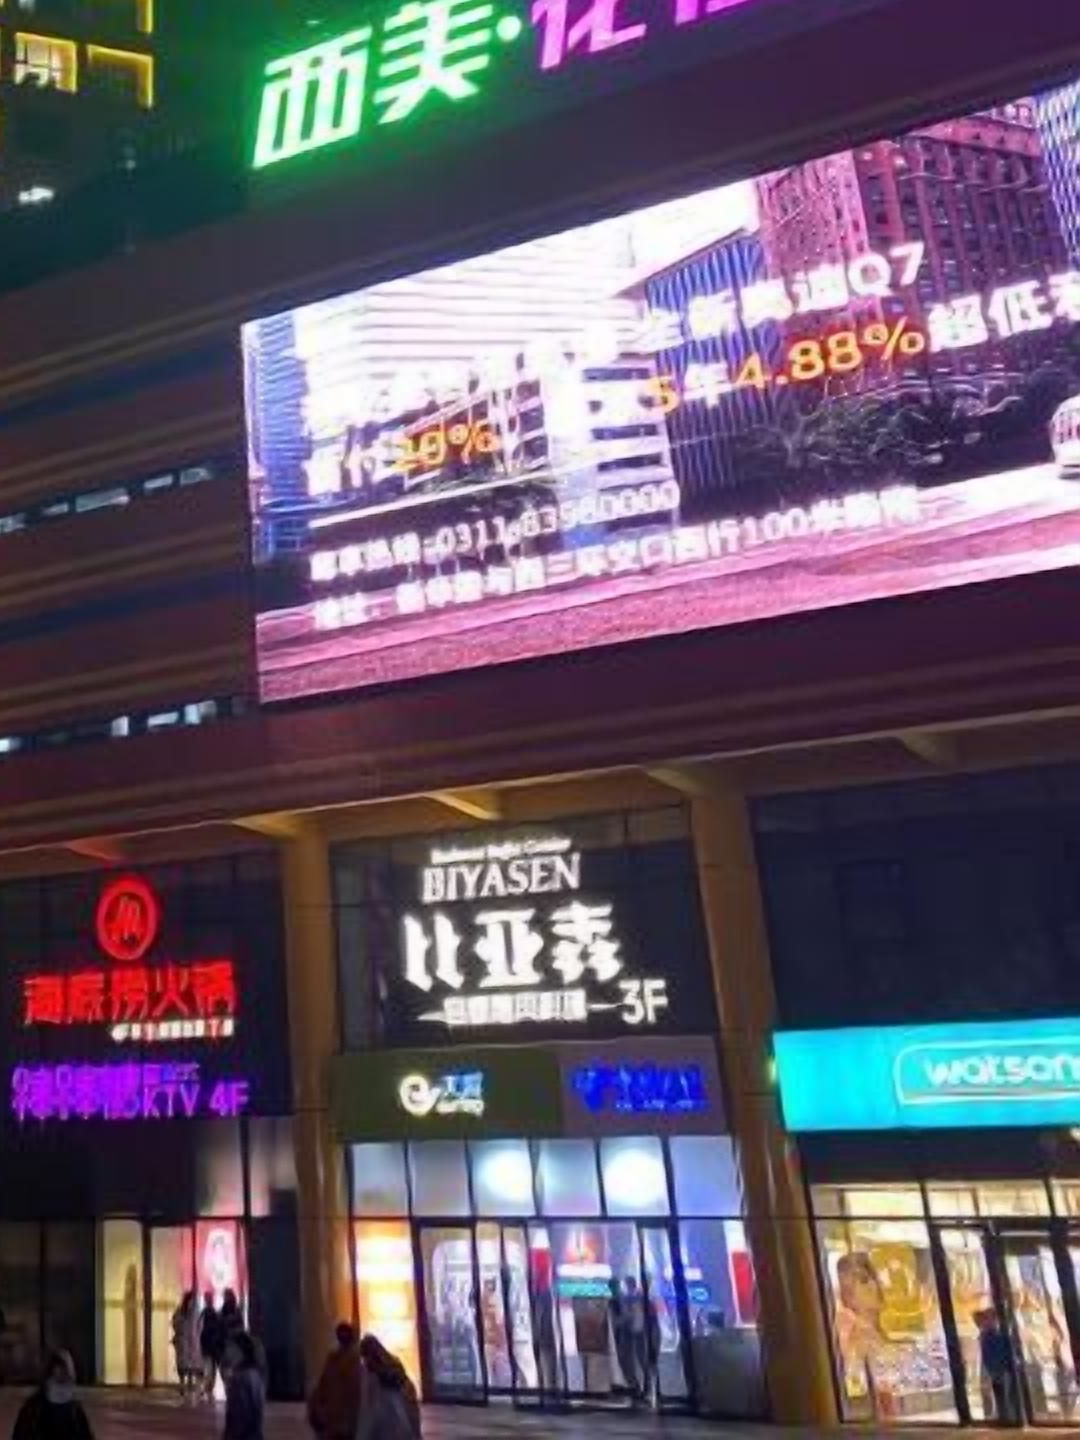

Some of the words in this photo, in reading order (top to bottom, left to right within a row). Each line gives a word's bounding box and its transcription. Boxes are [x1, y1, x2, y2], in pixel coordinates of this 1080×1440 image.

[422, 851, 581, 904] BIYASEN
[618, 978, 669, 1025] 3F
[208, 1080, 251, 1117] 4F
